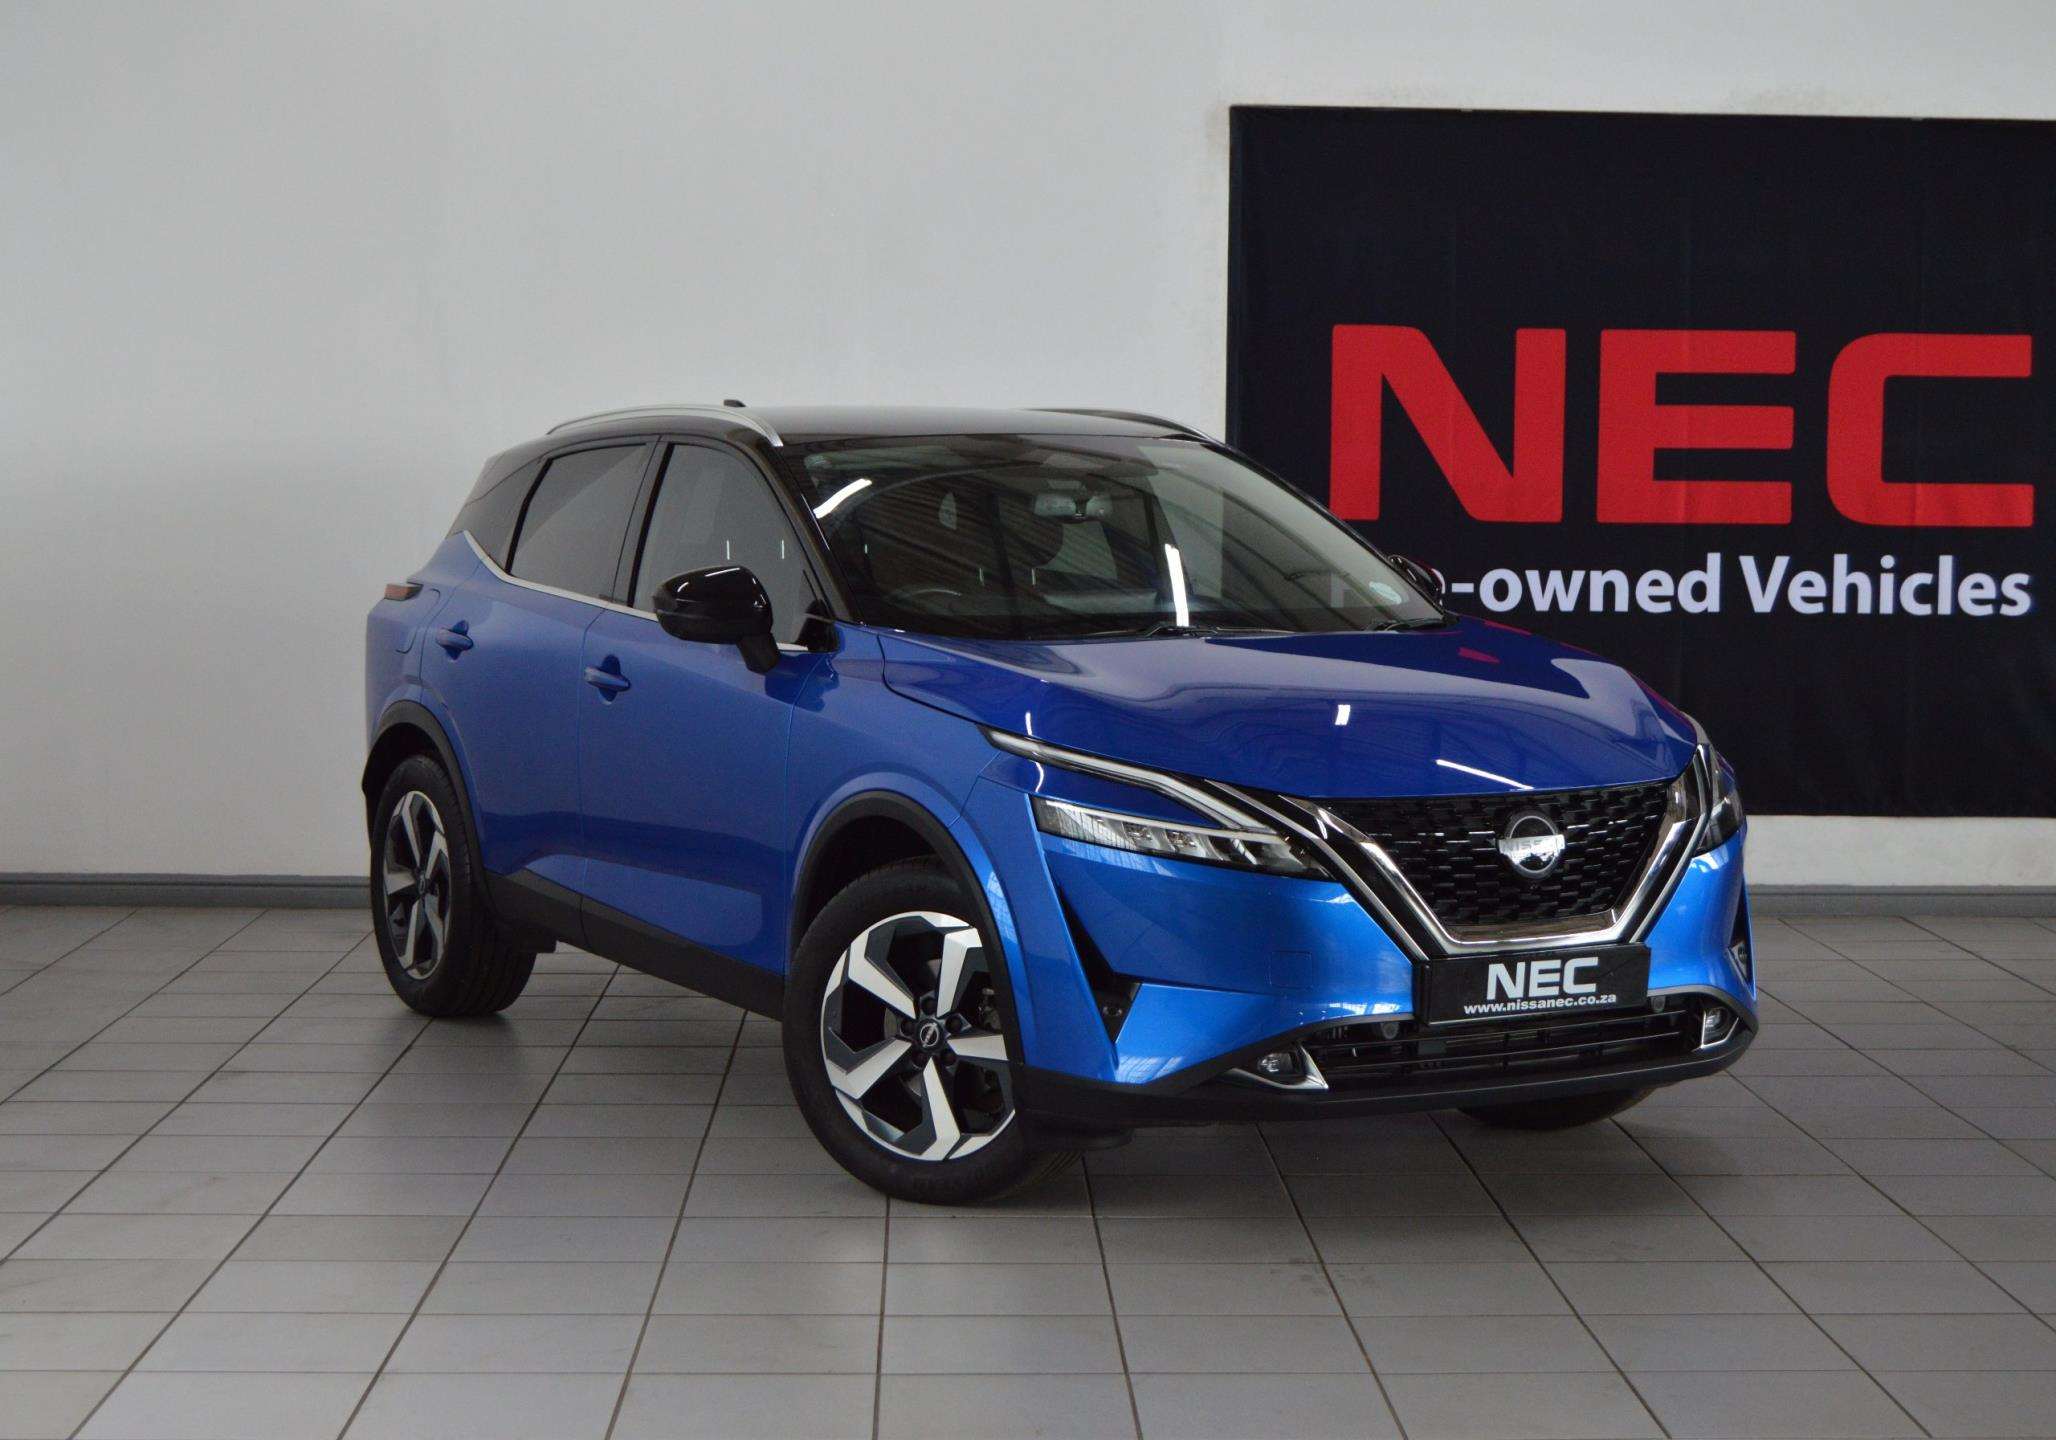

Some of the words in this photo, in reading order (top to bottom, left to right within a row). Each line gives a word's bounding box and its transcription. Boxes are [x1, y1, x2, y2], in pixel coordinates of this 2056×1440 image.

[1330, 325, 2034, 527] NEC
[1431, 552, 1720, 614] -owned
[1740, 553, 2031, 617] Vehicles
[1463, 993, 1617, 1015] www.nissanec.co.za
[1487, 957, 1599, 1000] NEC
